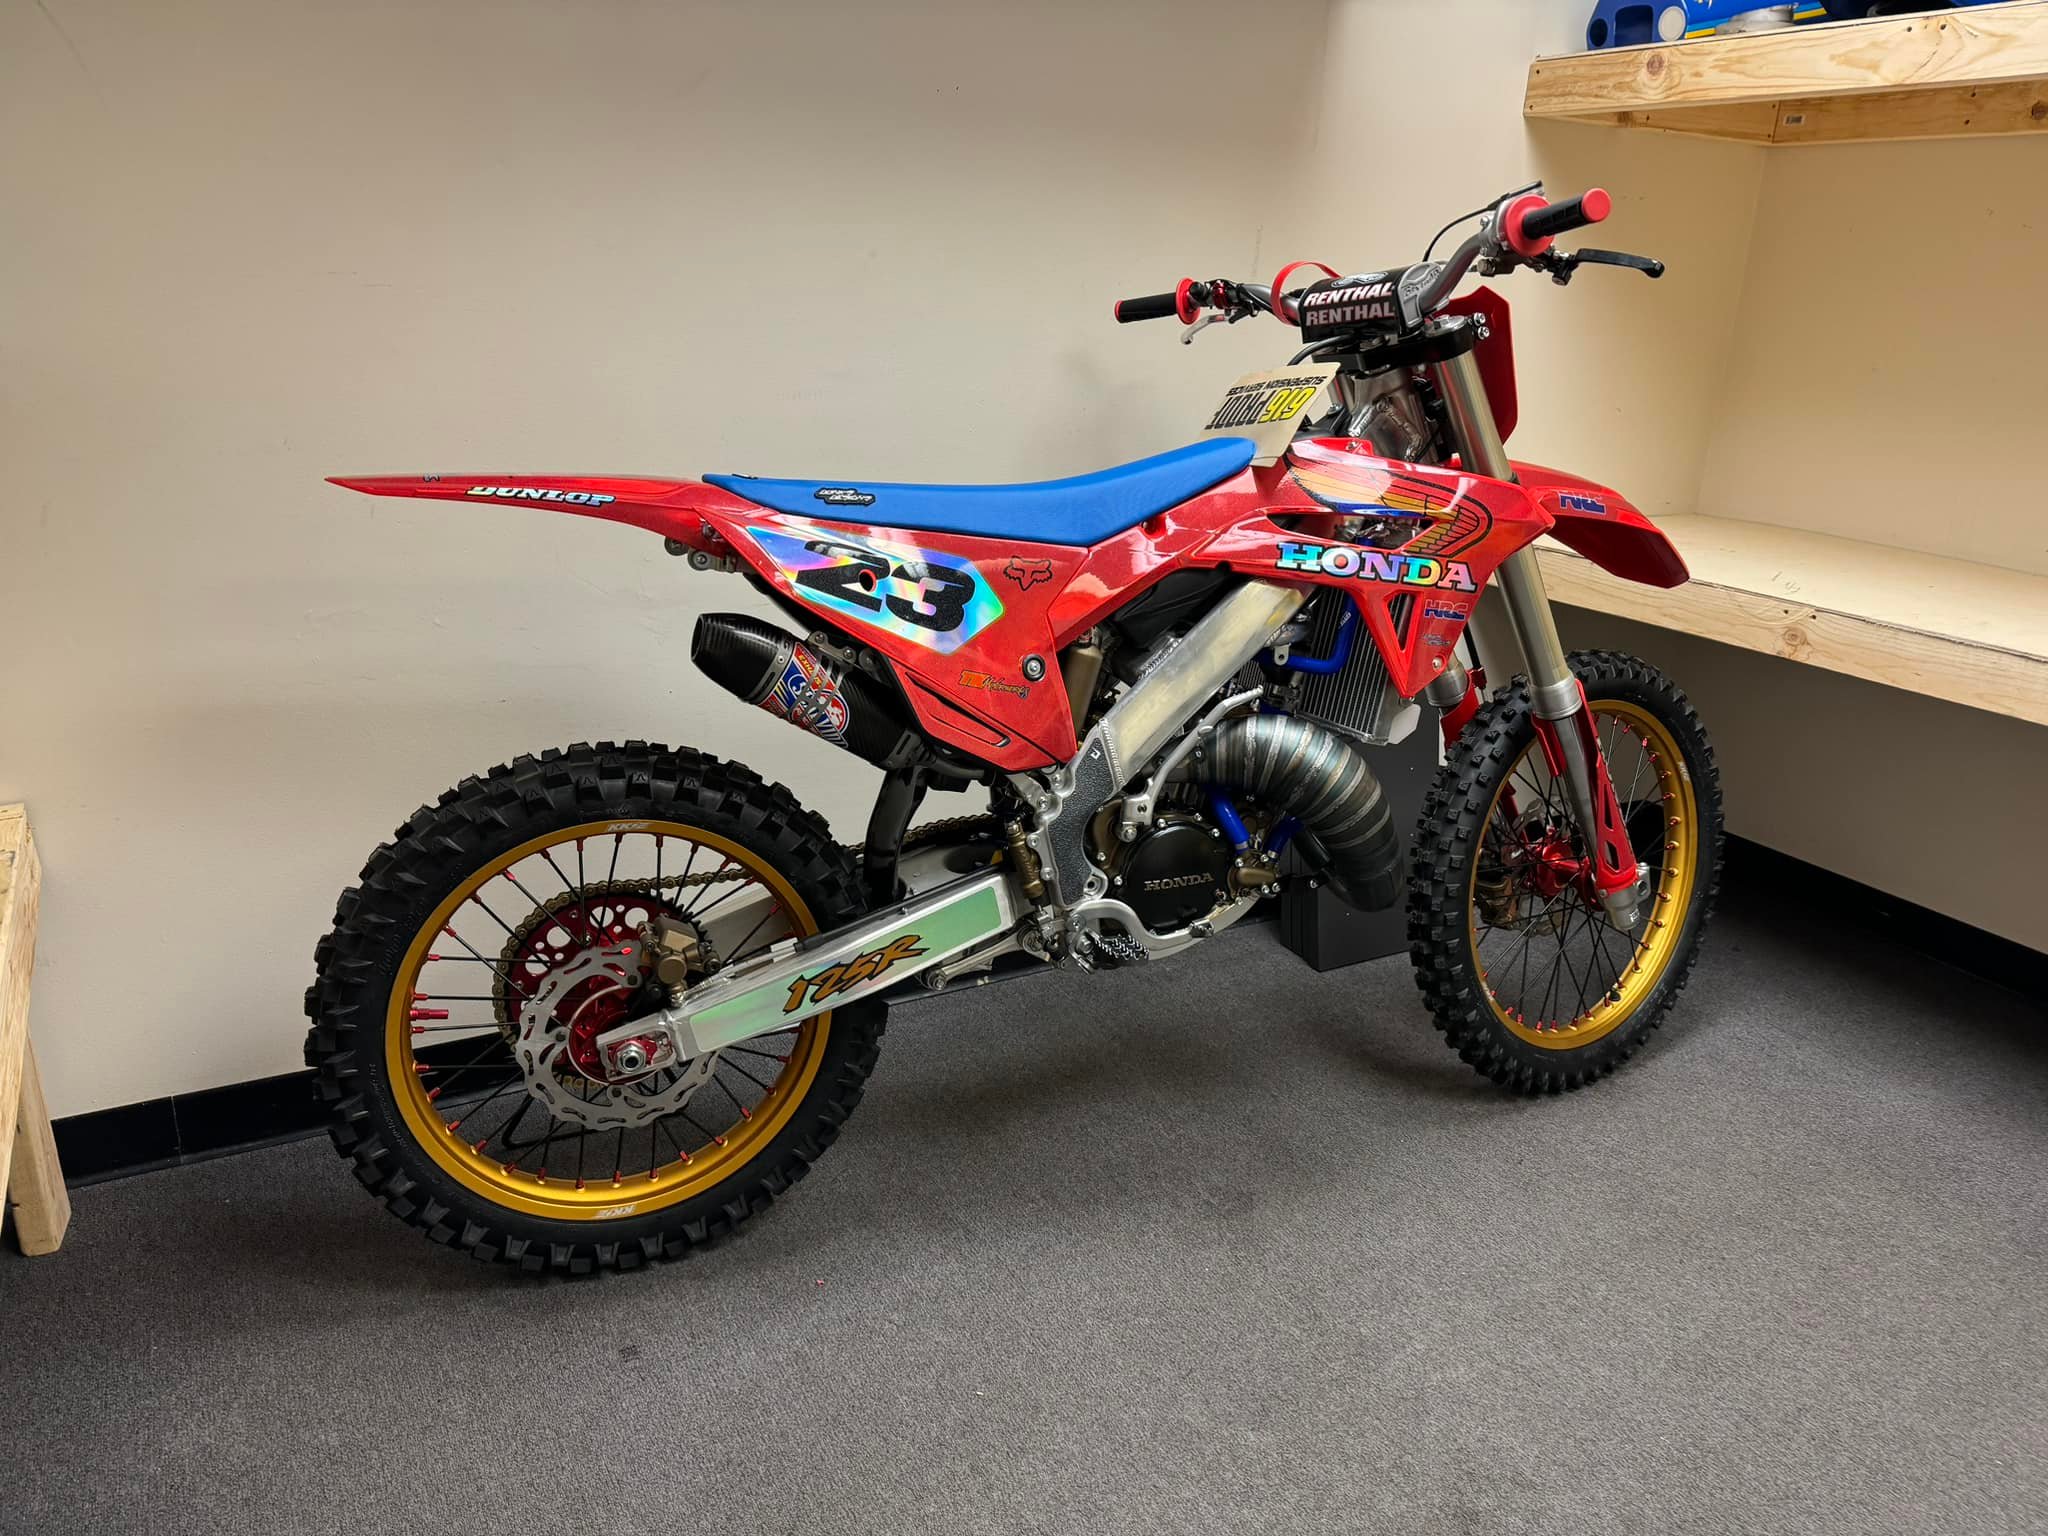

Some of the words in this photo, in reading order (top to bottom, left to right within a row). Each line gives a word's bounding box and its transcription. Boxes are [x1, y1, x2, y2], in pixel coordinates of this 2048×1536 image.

[1304, 282, 1393, 307] RENTHAL
[1306, 302, 1395, 327] RENTHAL
[1264, 376, 1328, 390] SUSPENSION
[465, 486, 616, 507] DUNLOP
[1276, 542, 1477, 592] HONDA
[795, 540, 976, 632] 23
[1424, 599, 1469, 622] HRC
[1143, 872, 1215, 892] HONDA
[783, 935, 930, 1015] 125R
